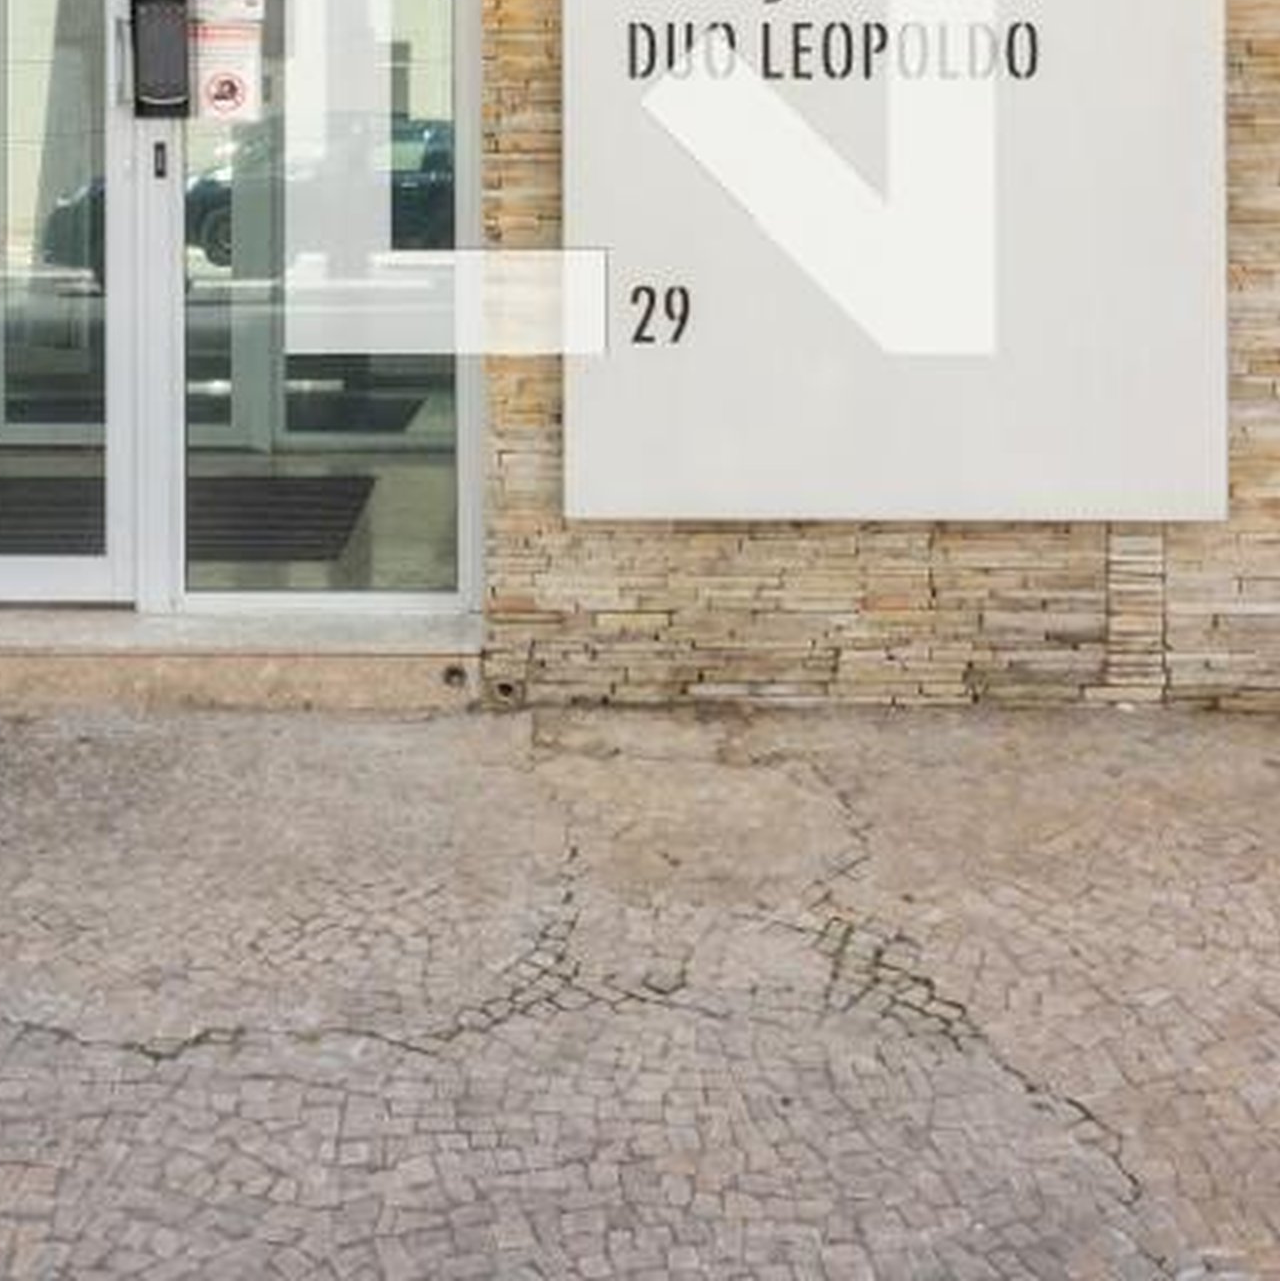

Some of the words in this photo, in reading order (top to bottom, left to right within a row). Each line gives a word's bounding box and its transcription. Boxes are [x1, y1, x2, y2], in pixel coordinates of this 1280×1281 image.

[628, 22, 738, 80] DUO
[762, 21, 1041, 80] LEOPOLDO
[630, 285, 692, 345] 29
